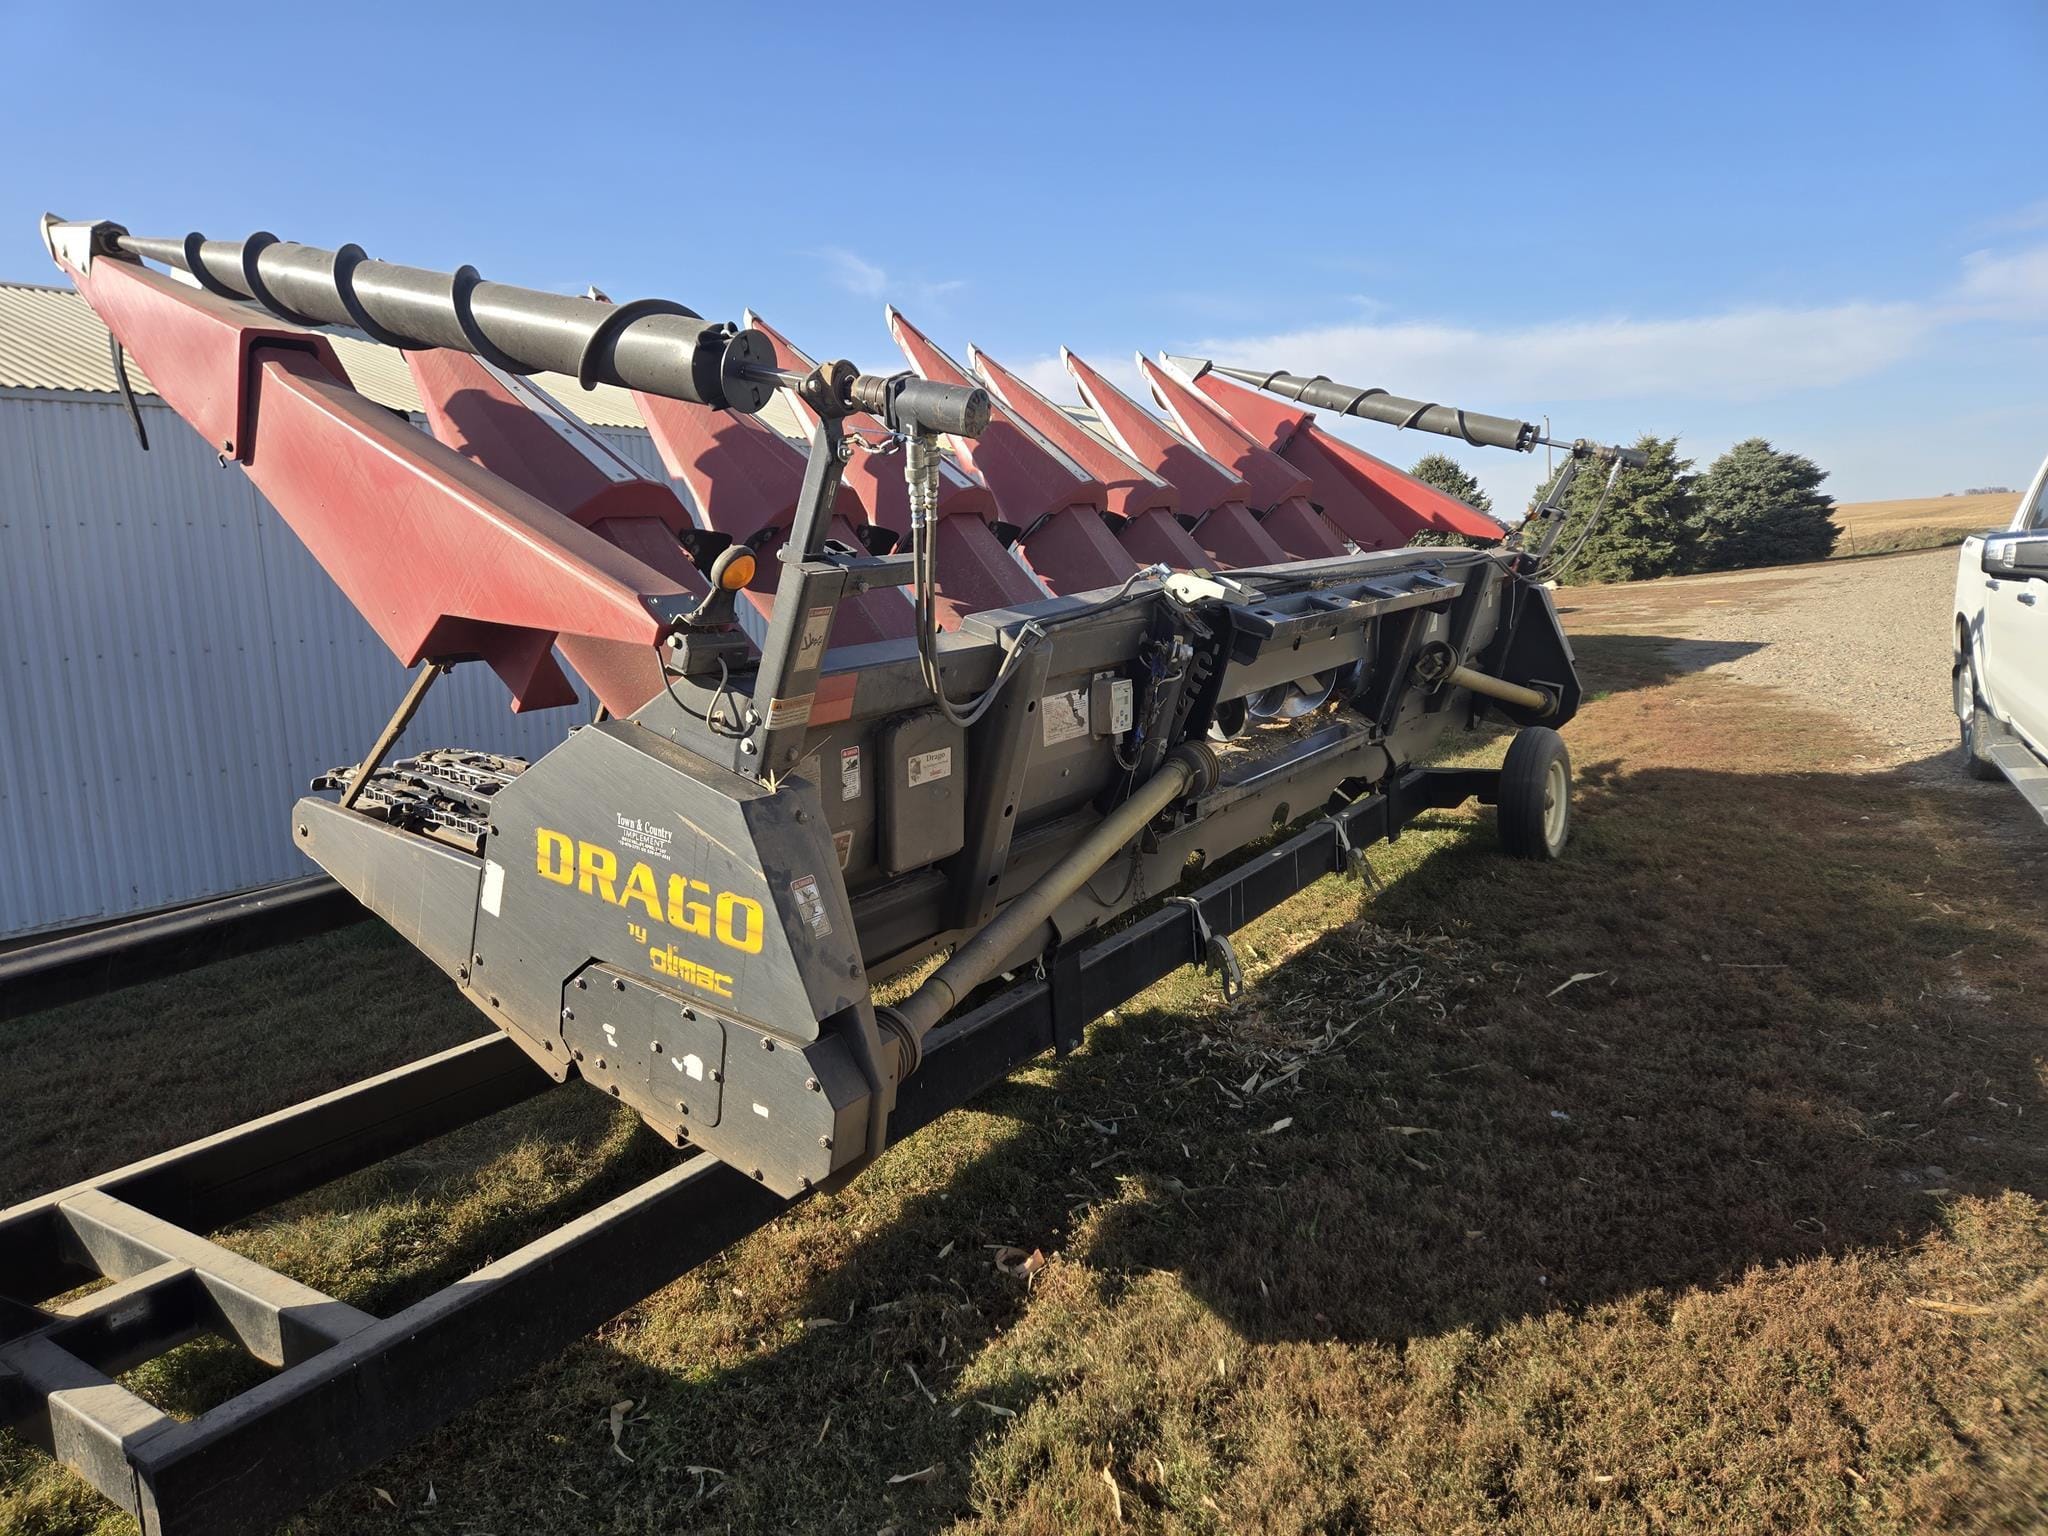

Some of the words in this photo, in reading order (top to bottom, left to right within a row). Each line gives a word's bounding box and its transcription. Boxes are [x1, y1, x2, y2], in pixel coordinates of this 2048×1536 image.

[926, 752, 946, 762] Drago
[616, 812, 635, 829] Town
[636, 818, 643, 831] &
[645, 821, 672, 844] Country
[623, 829, 664, 848] IMPLEMENT
[536, 827, 764, 954] DRAGO
[649, 943, 734, 999] olimac
